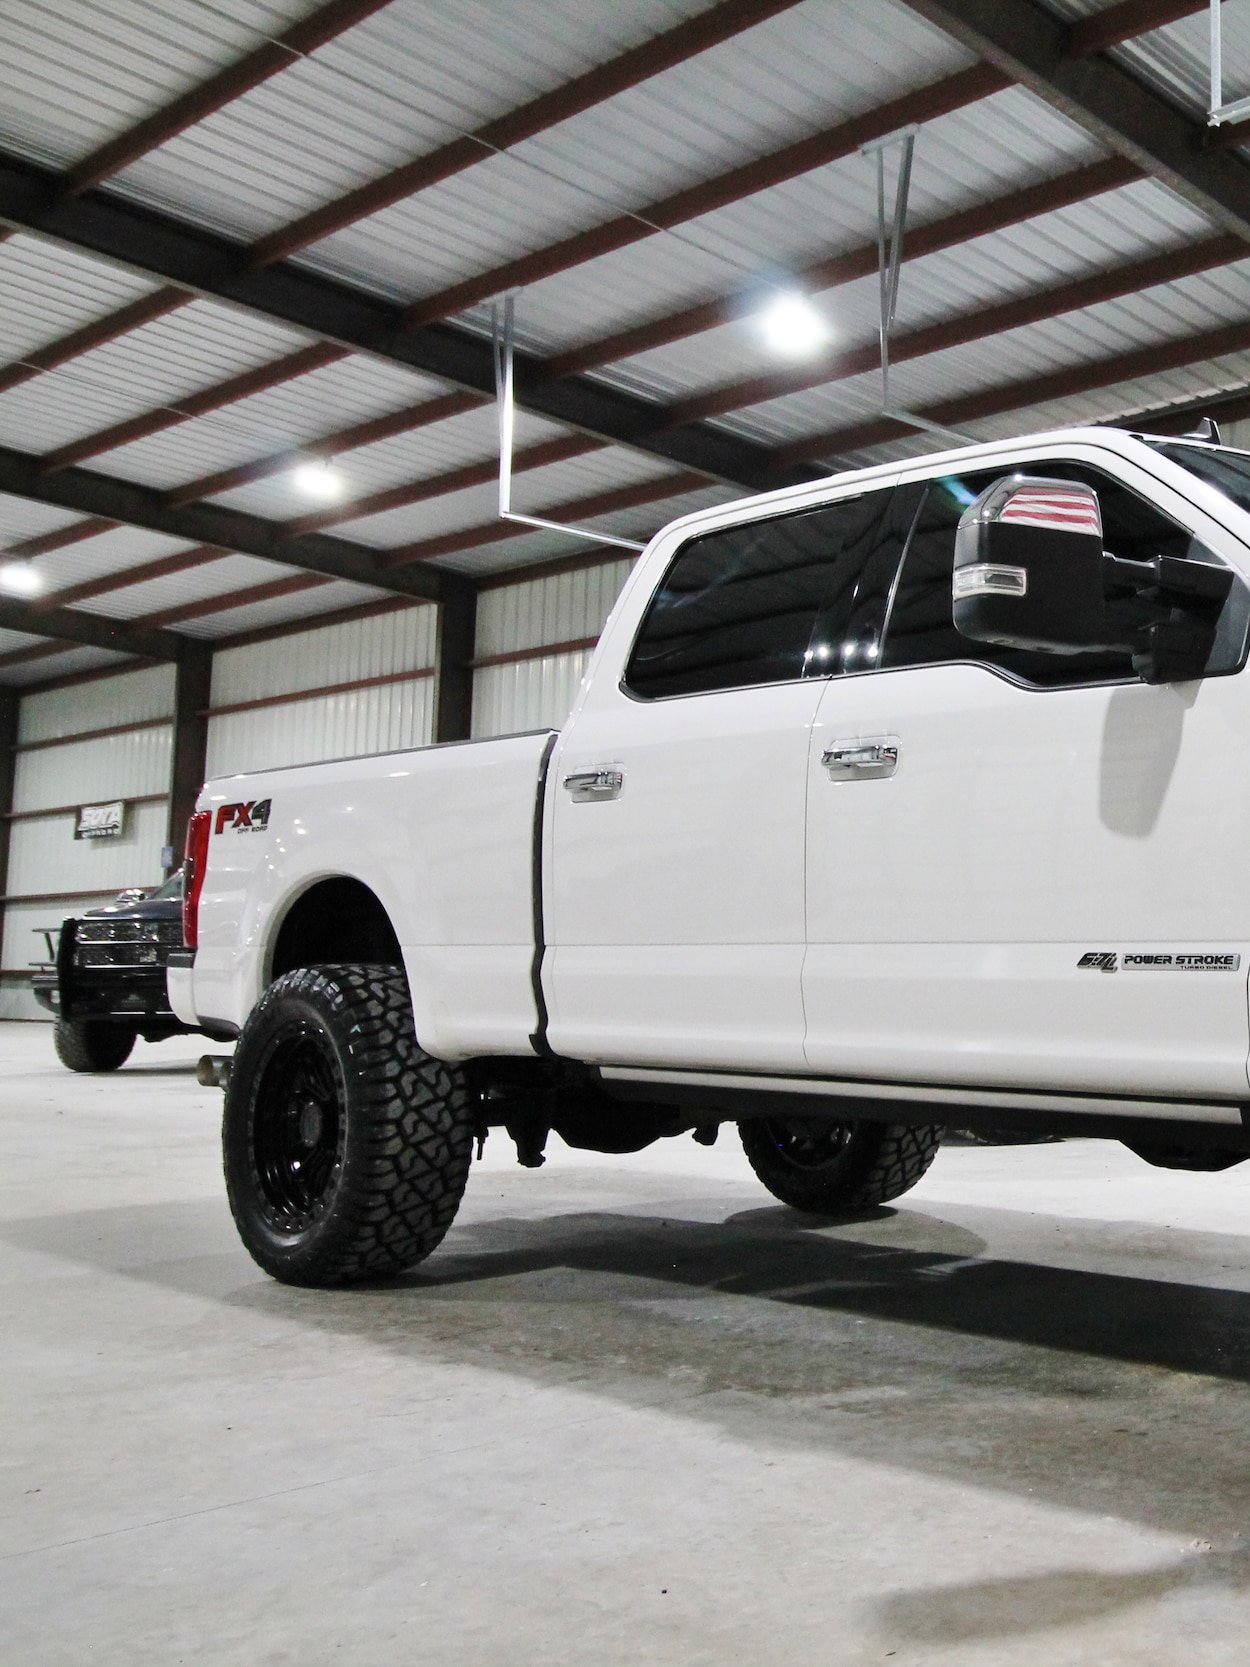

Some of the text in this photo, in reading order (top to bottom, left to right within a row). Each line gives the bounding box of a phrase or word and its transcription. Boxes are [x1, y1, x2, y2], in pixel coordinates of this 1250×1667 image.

[215, 798, 272, 835] FX4
[1124, 955, 1172, 965] POWER
[1175, 955, 1234, 965] STROKE
